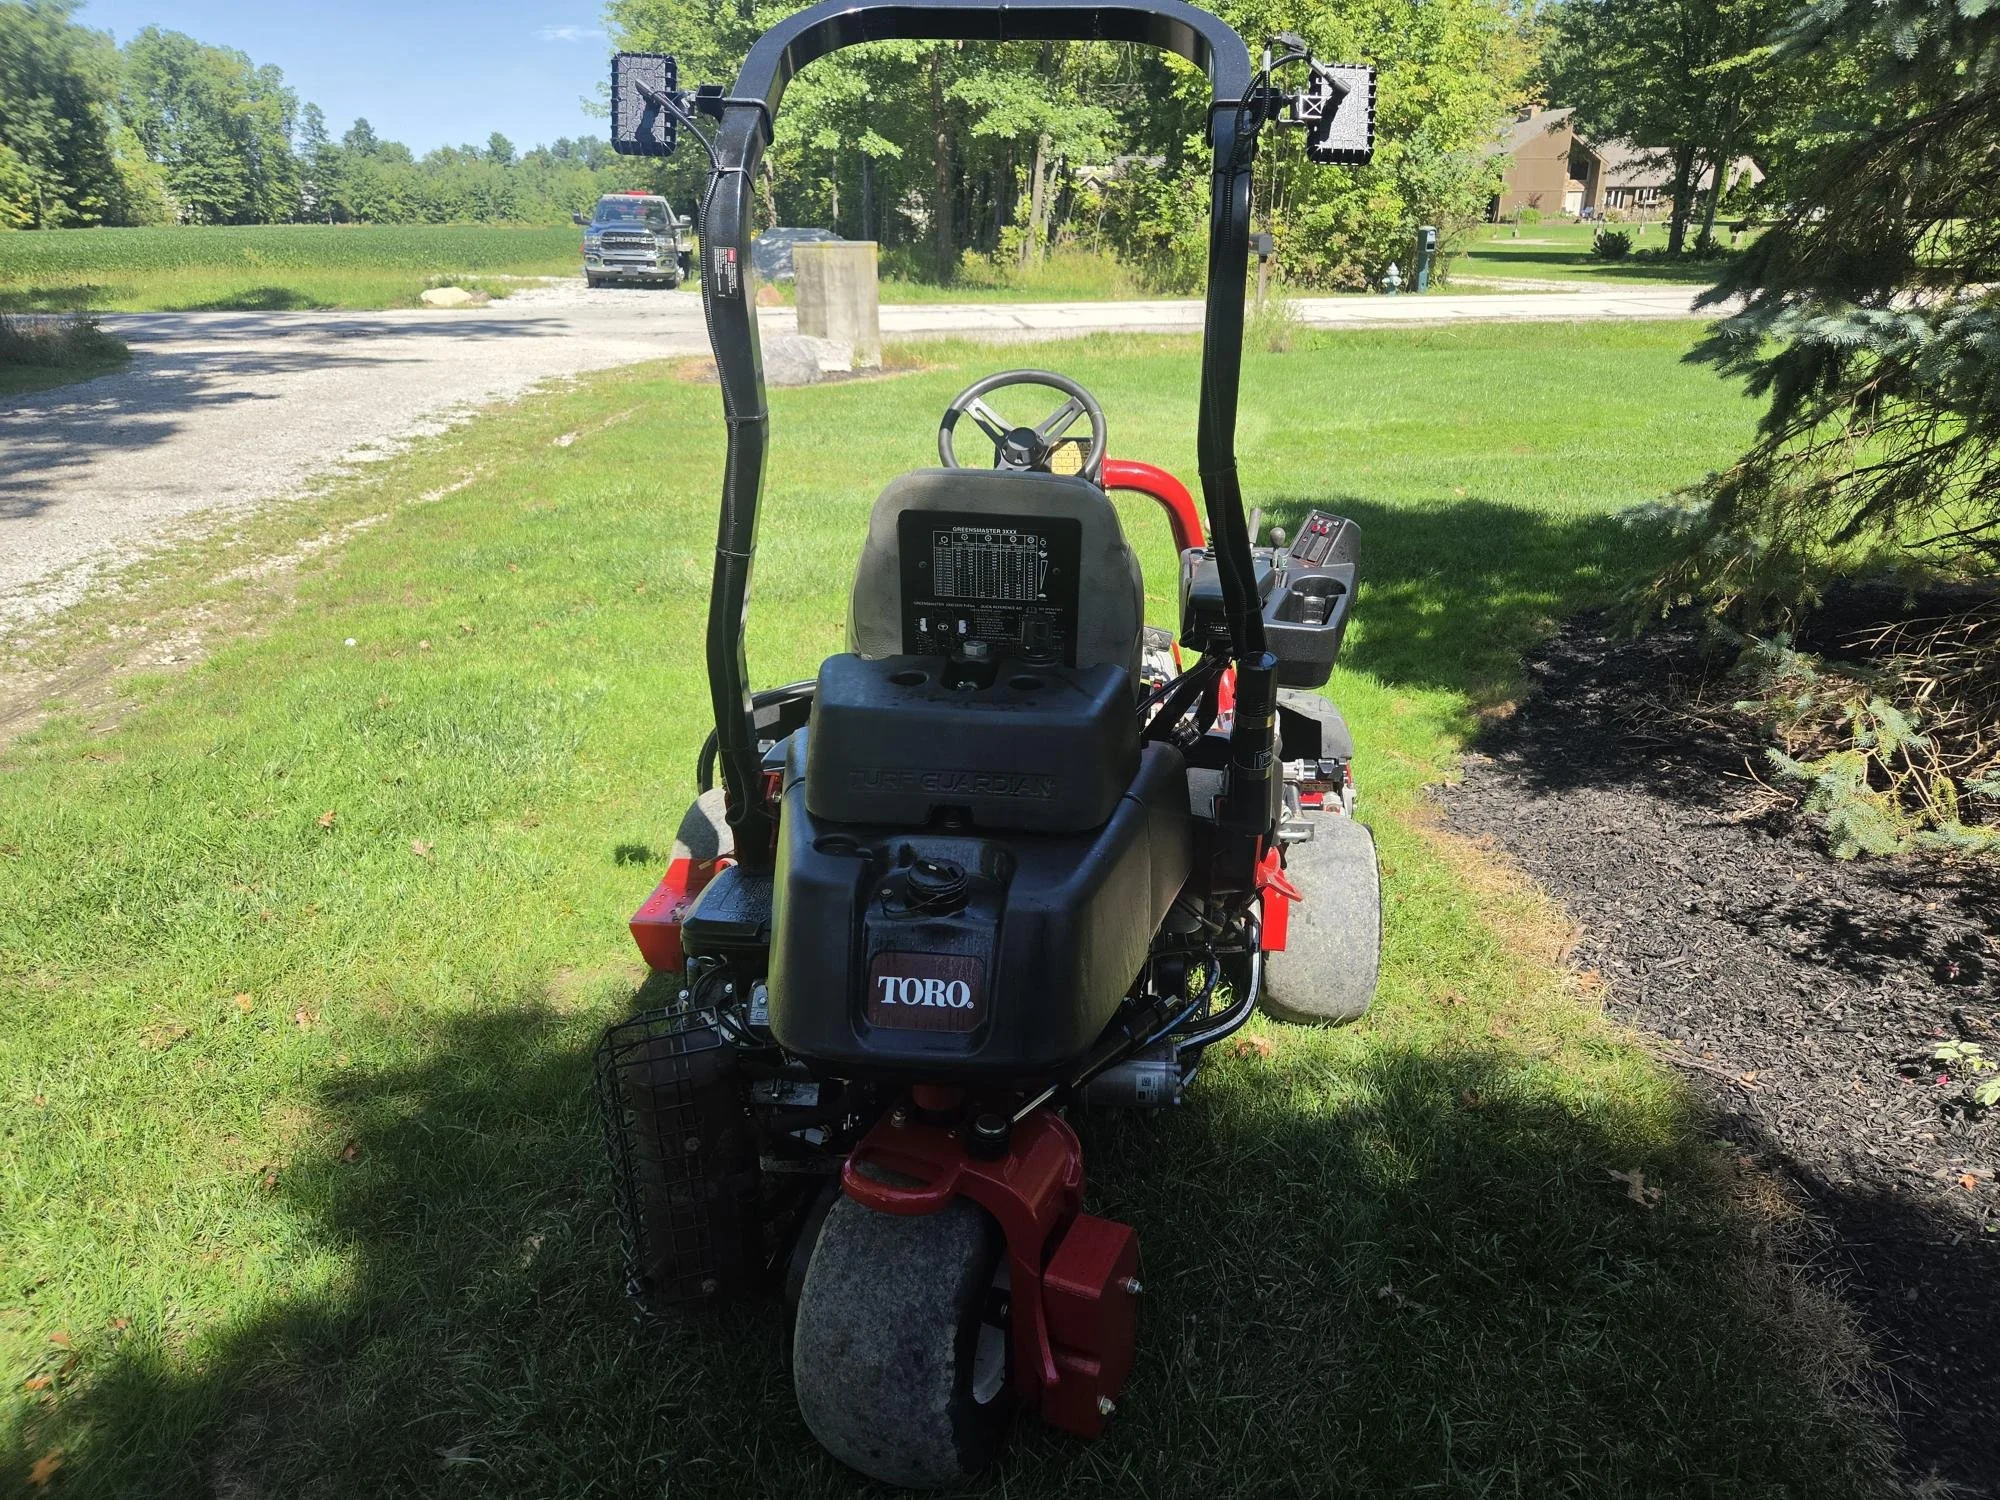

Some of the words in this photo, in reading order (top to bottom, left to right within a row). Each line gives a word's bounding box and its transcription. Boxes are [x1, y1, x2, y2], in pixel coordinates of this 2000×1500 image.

[952, 526, 1001, 534] GREENSMASTER
[849, 770, 913, 790] TURF
[920, 771, 1057, 799] GUARDIAN
[878, 976, 971, 1008] TORO
